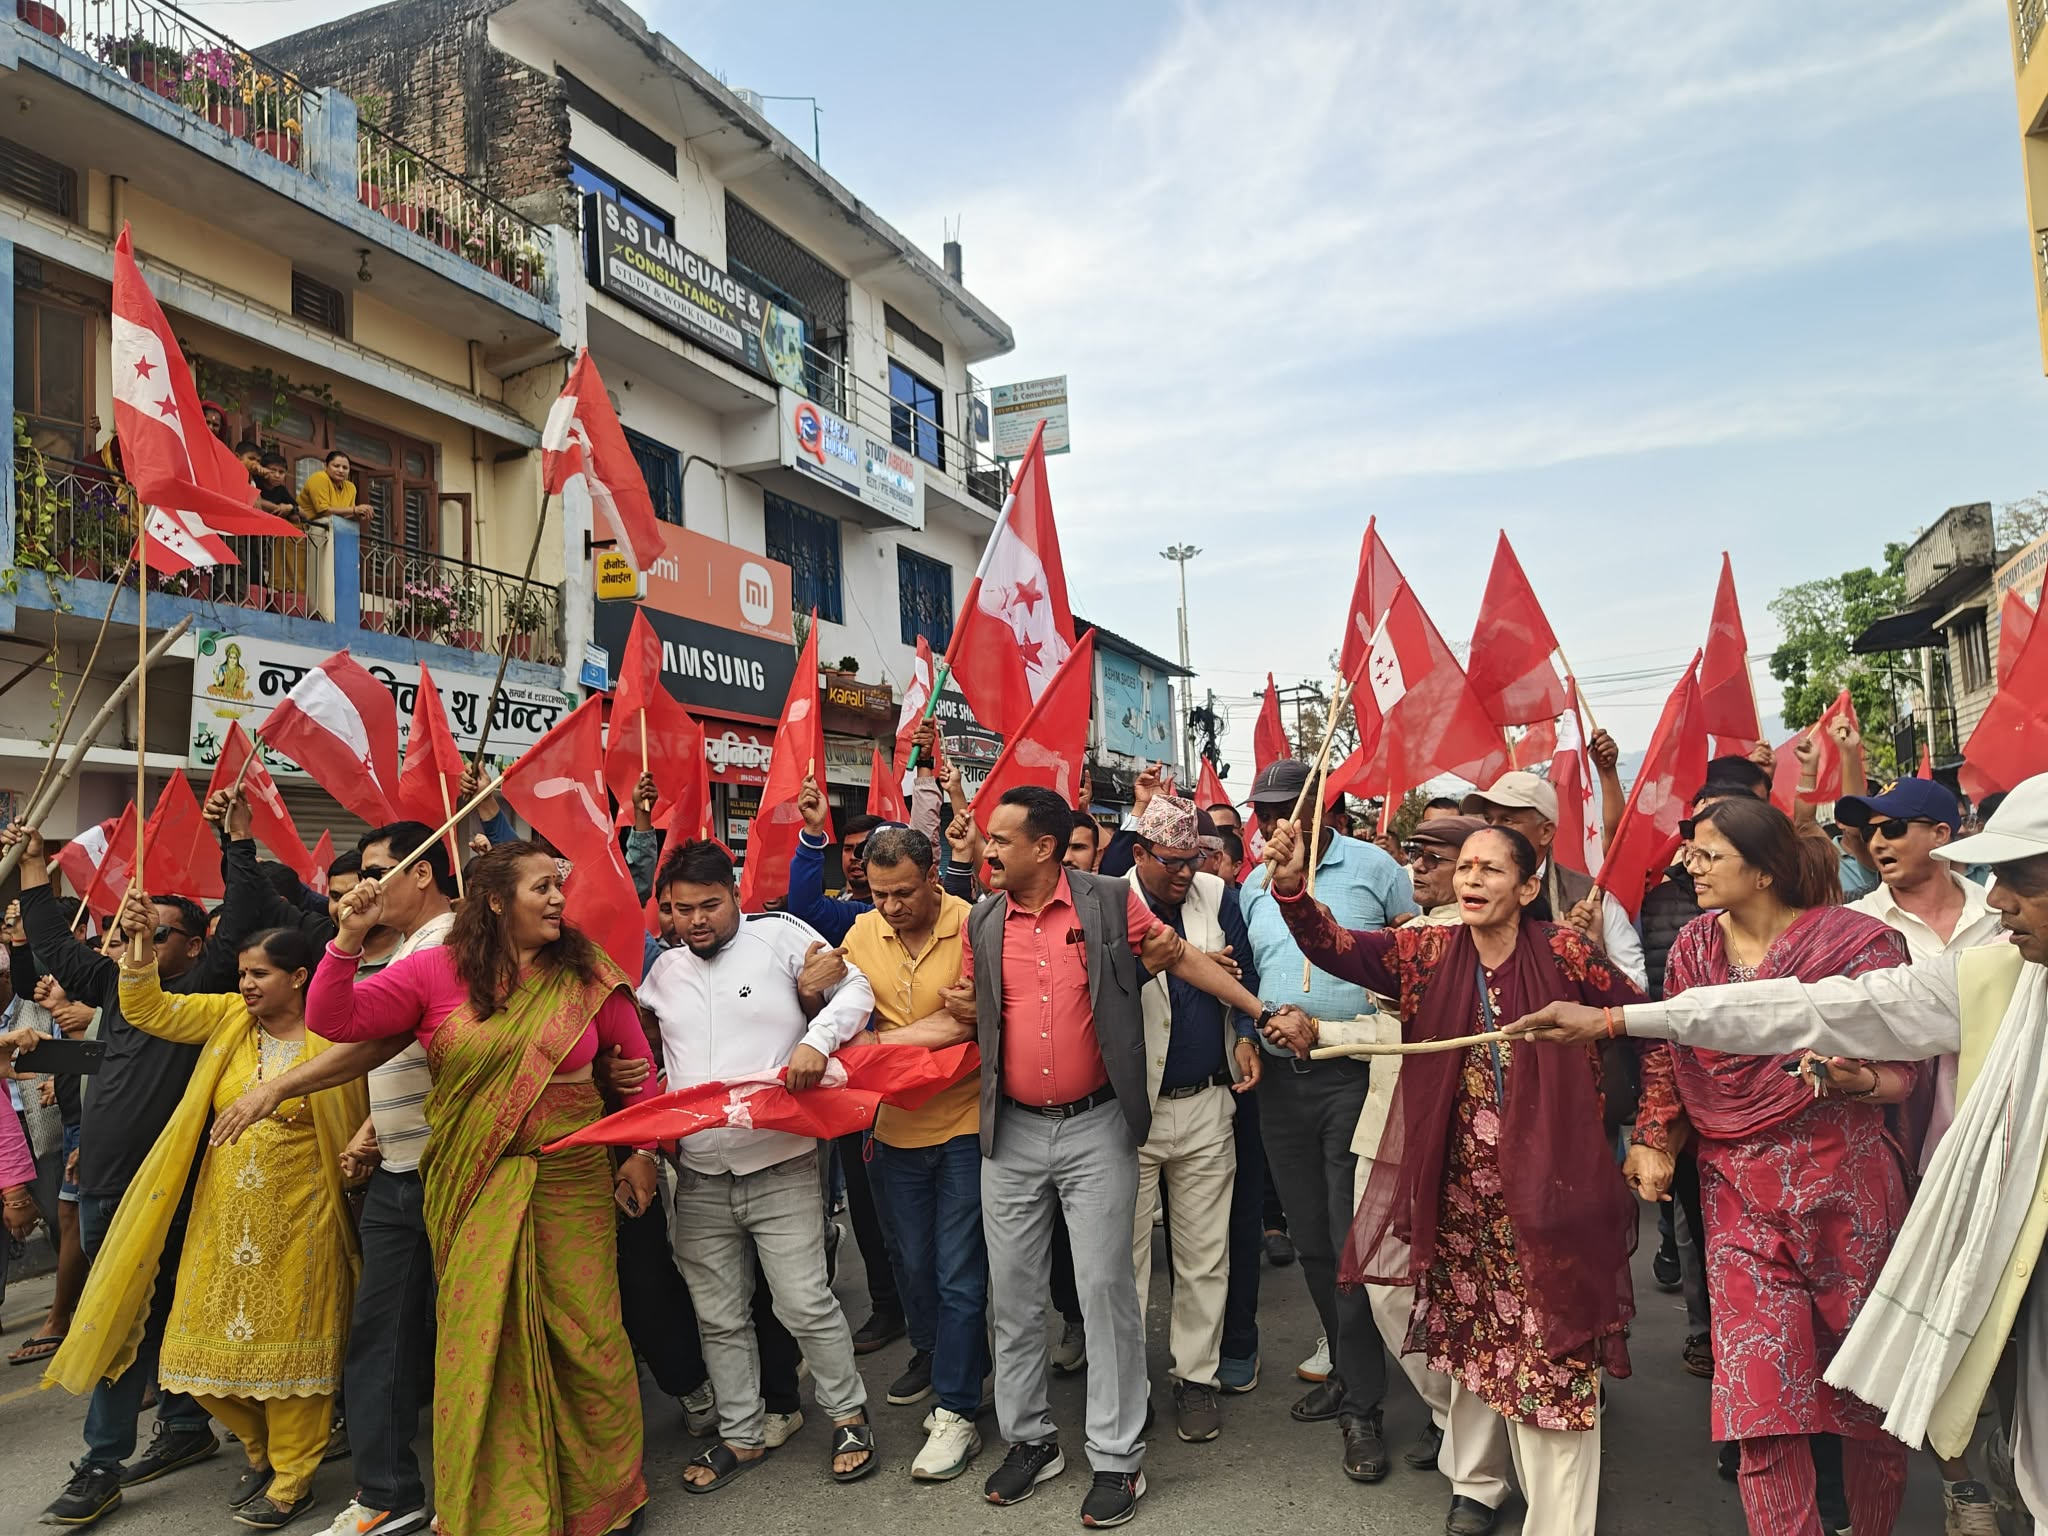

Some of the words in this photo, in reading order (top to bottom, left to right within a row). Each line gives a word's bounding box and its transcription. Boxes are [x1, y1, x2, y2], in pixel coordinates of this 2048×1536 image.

[605, 203, 639, 244] S.S
[644, 227, 747, 312] LANGUAGE
[748, 295, 761, 320] &
[624, 246, 726, 319] CONSULTANCY
[615, 264, 652, 292] STUDY
[653, 284, 662, 297] &
[663, 291, 698, 318] WORK
[698, 311, 707, 325] IN
[708, 320, 739, 343] JAPAN
[865, 438, 888, 465] STUDY
[888, 452, 914, 480] ABROAD
[935, 699, 958, 719] SHOE
